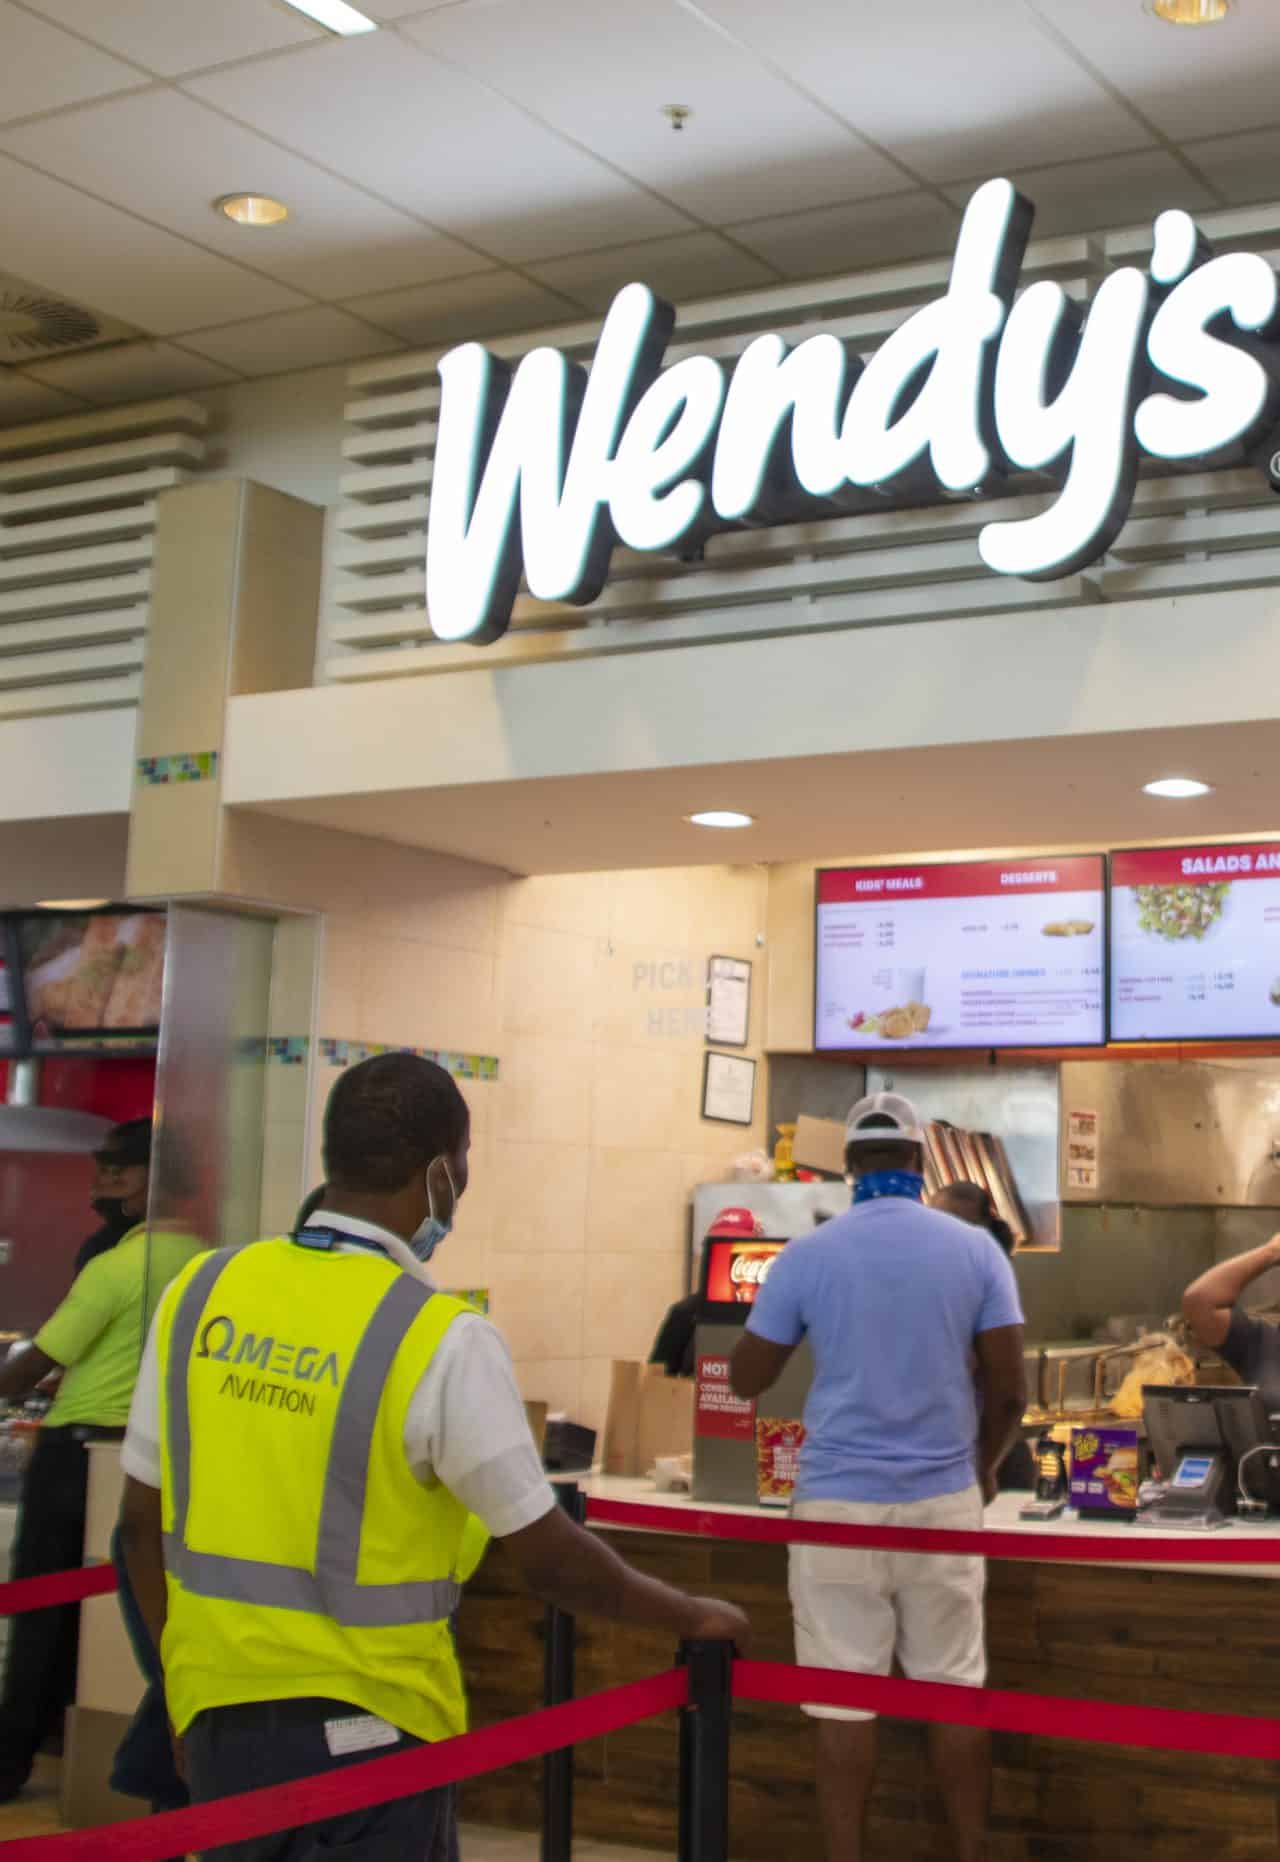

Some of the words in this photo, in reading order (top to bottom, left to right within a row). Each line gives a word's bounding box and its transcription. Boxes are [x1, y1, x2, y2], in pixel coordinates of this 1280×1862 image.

[425, 177, 1279, 644] Wendy's
[1181, 856, 1251, 875] SALADS
[886, 876, 923, 891] MEALS
[1000, 871, 1057, 885] DESSERTS
[219, 1373, 316, 1417] AVIATION
